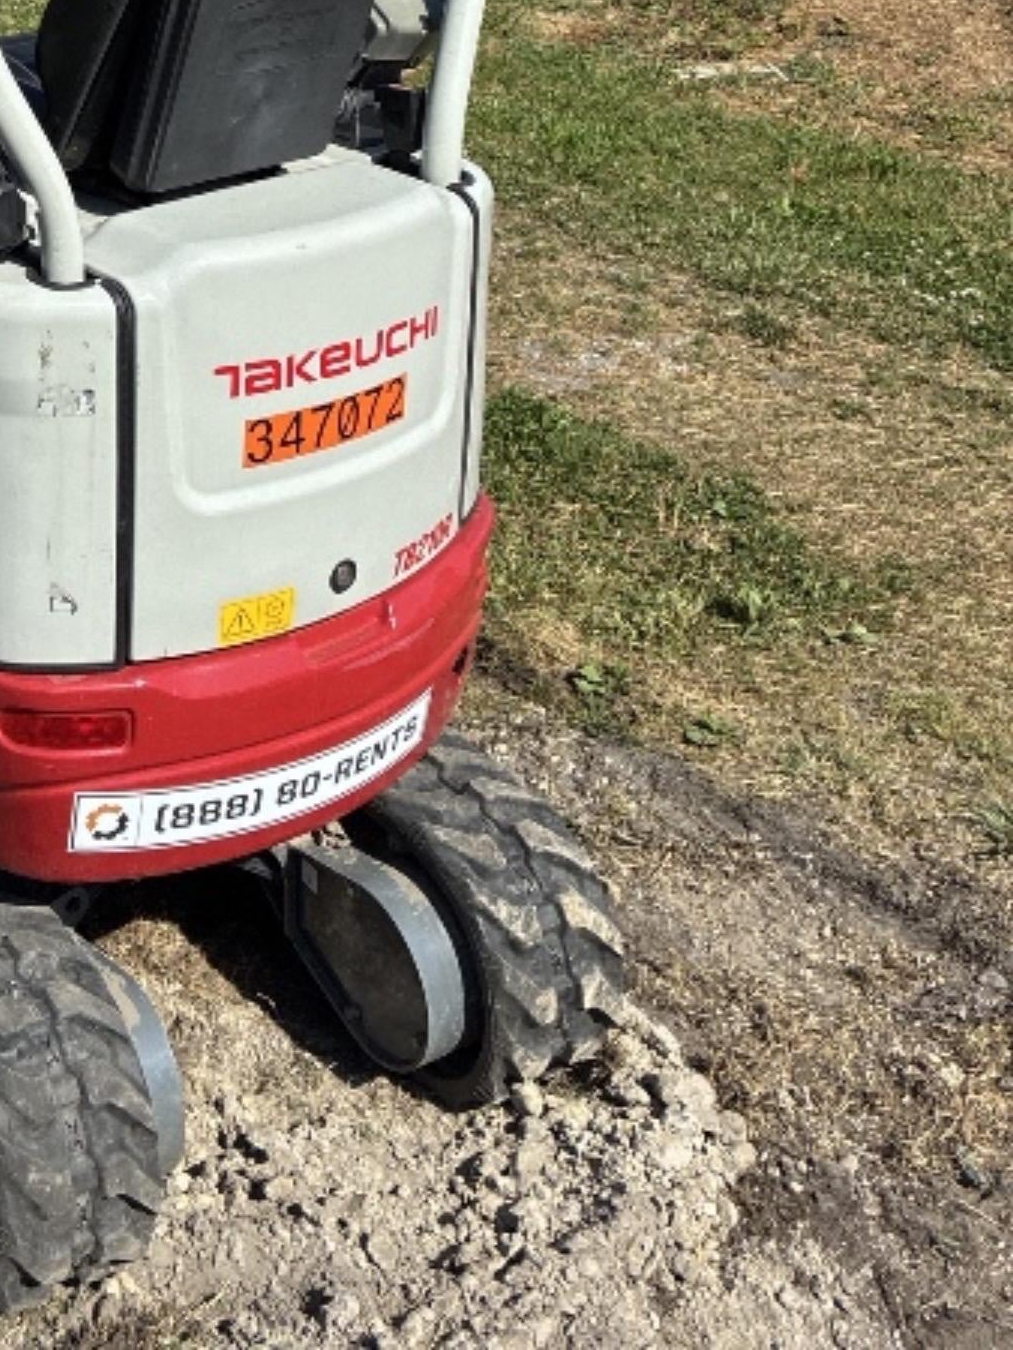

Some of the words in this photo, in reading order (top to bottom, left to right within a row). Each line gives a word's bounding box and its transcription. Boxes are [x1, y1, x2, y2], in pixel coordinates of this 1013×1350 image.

[246, 376, 405, 463] 347072
[154, 787, 264, 834] (888)
[276, 714, 420, 807] 80-RENTS
